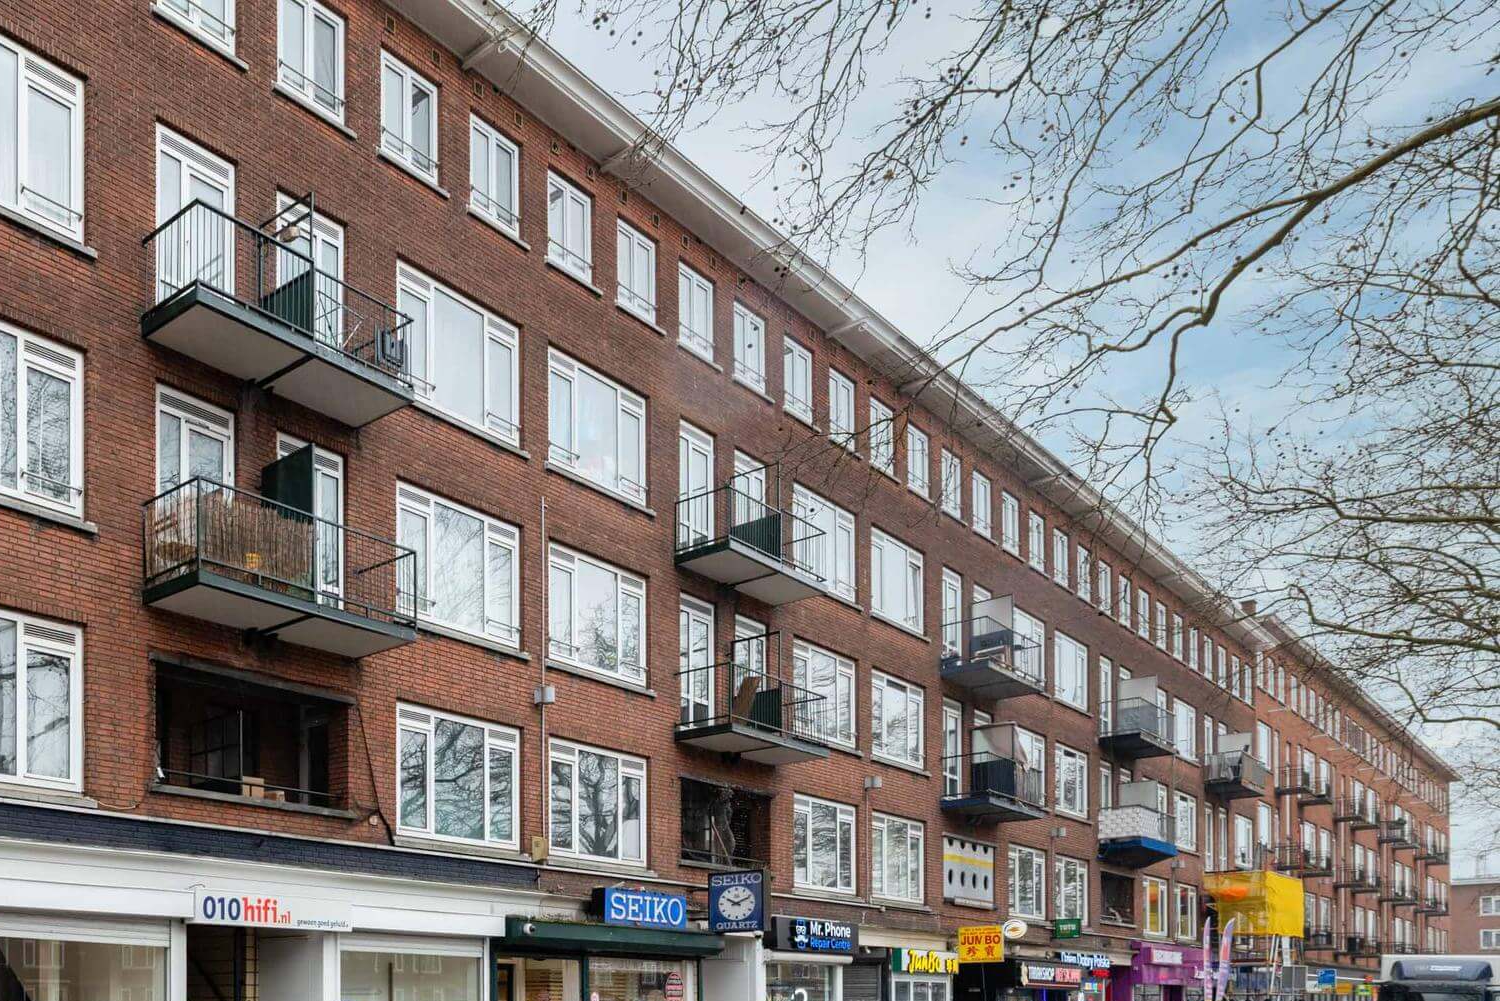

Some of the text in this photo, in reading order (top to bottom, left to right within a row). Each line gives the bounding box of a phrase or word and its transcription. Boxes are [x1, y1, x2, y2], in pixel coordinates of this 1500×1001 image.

[711, 872, 762, 887] SEIKO
[202, 895, 291, 924] 010hifi.nl
[610, 892, 684, 926] SEIKO
[715, 921, 758, 930] QUARTZ
[810, 921, 851, 938] Mr. Phone
[985, 934, 1001, 945] BO
